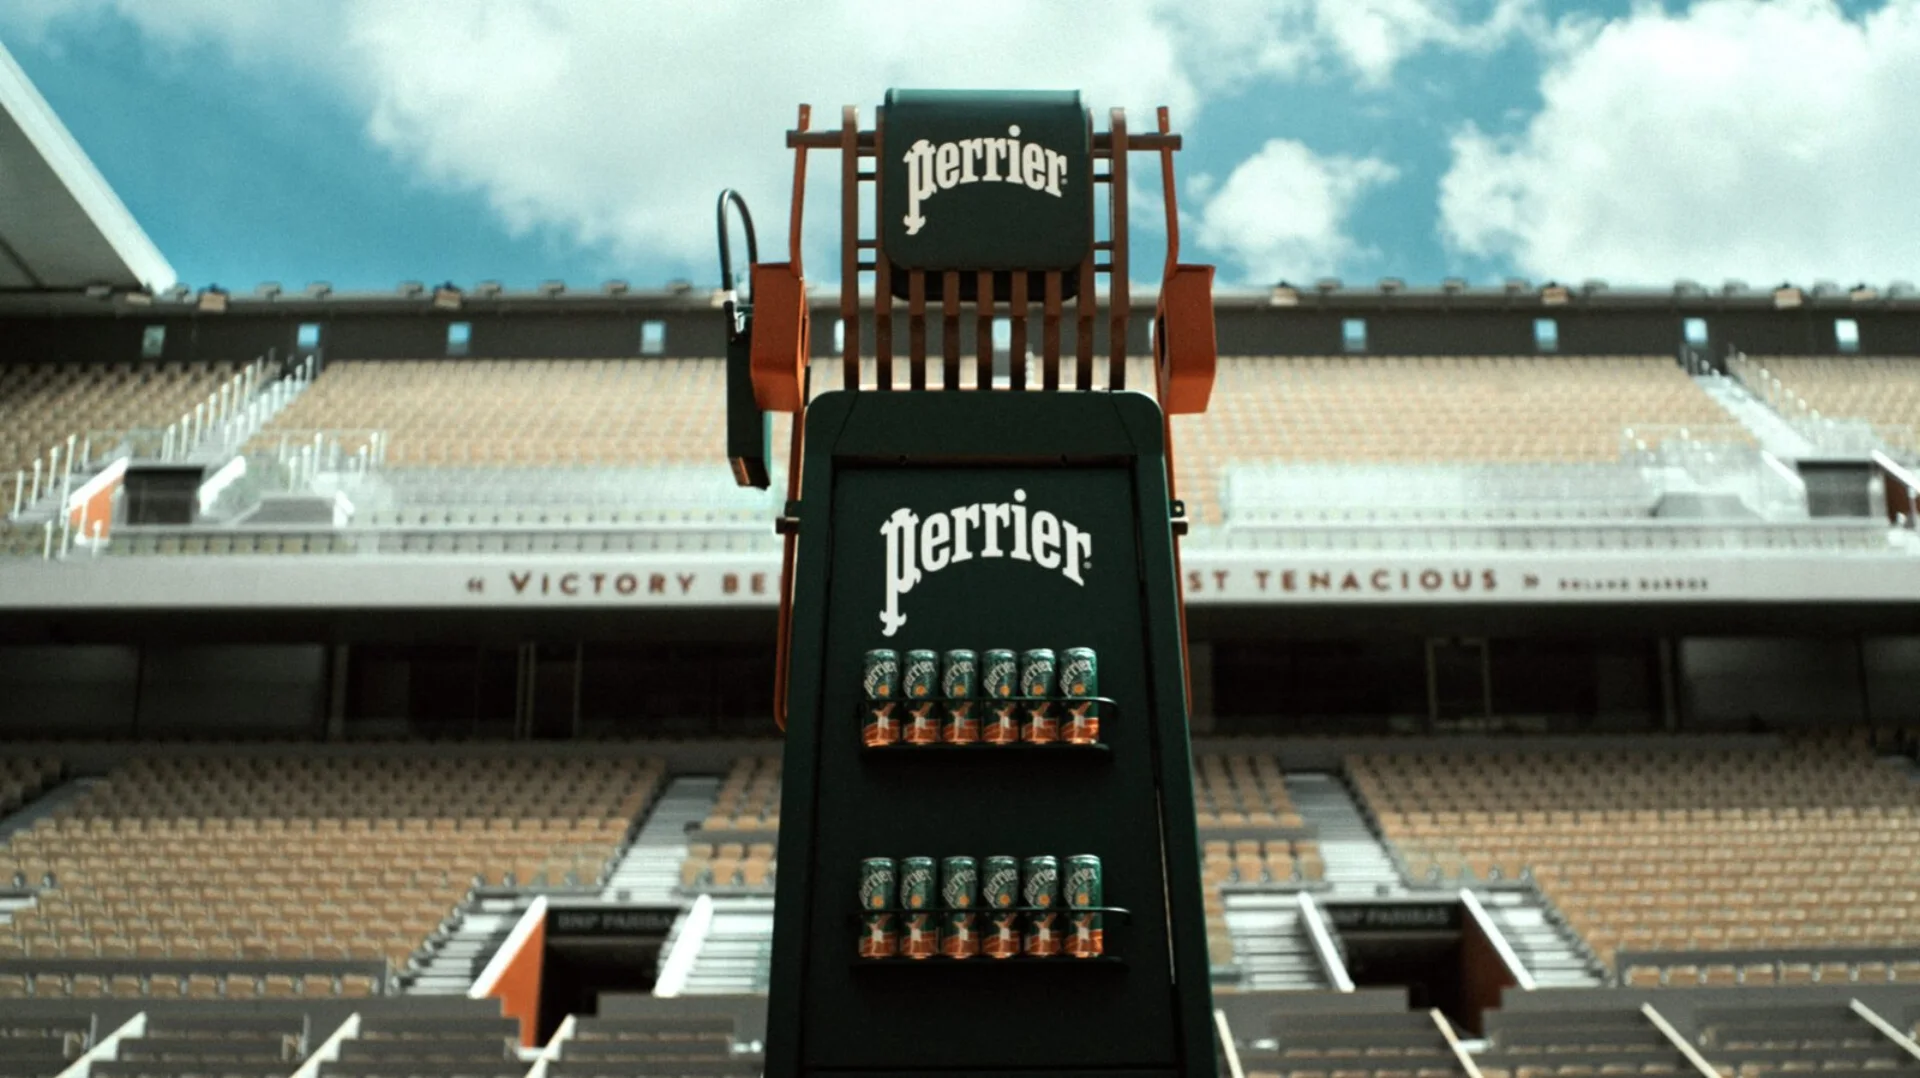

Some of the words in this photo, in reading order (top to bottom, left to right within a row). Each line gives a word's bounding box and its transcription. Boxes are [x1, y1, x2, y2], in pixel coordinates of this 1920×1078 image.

[903, 124, 1068, 236] perrier
[508, 571, 696, 595] VICTORY
[721, 573, 784, 595] BE
[879, 488, 1092, 637] perrier
[1254, 568, 1498, 592] TENACIOUS
